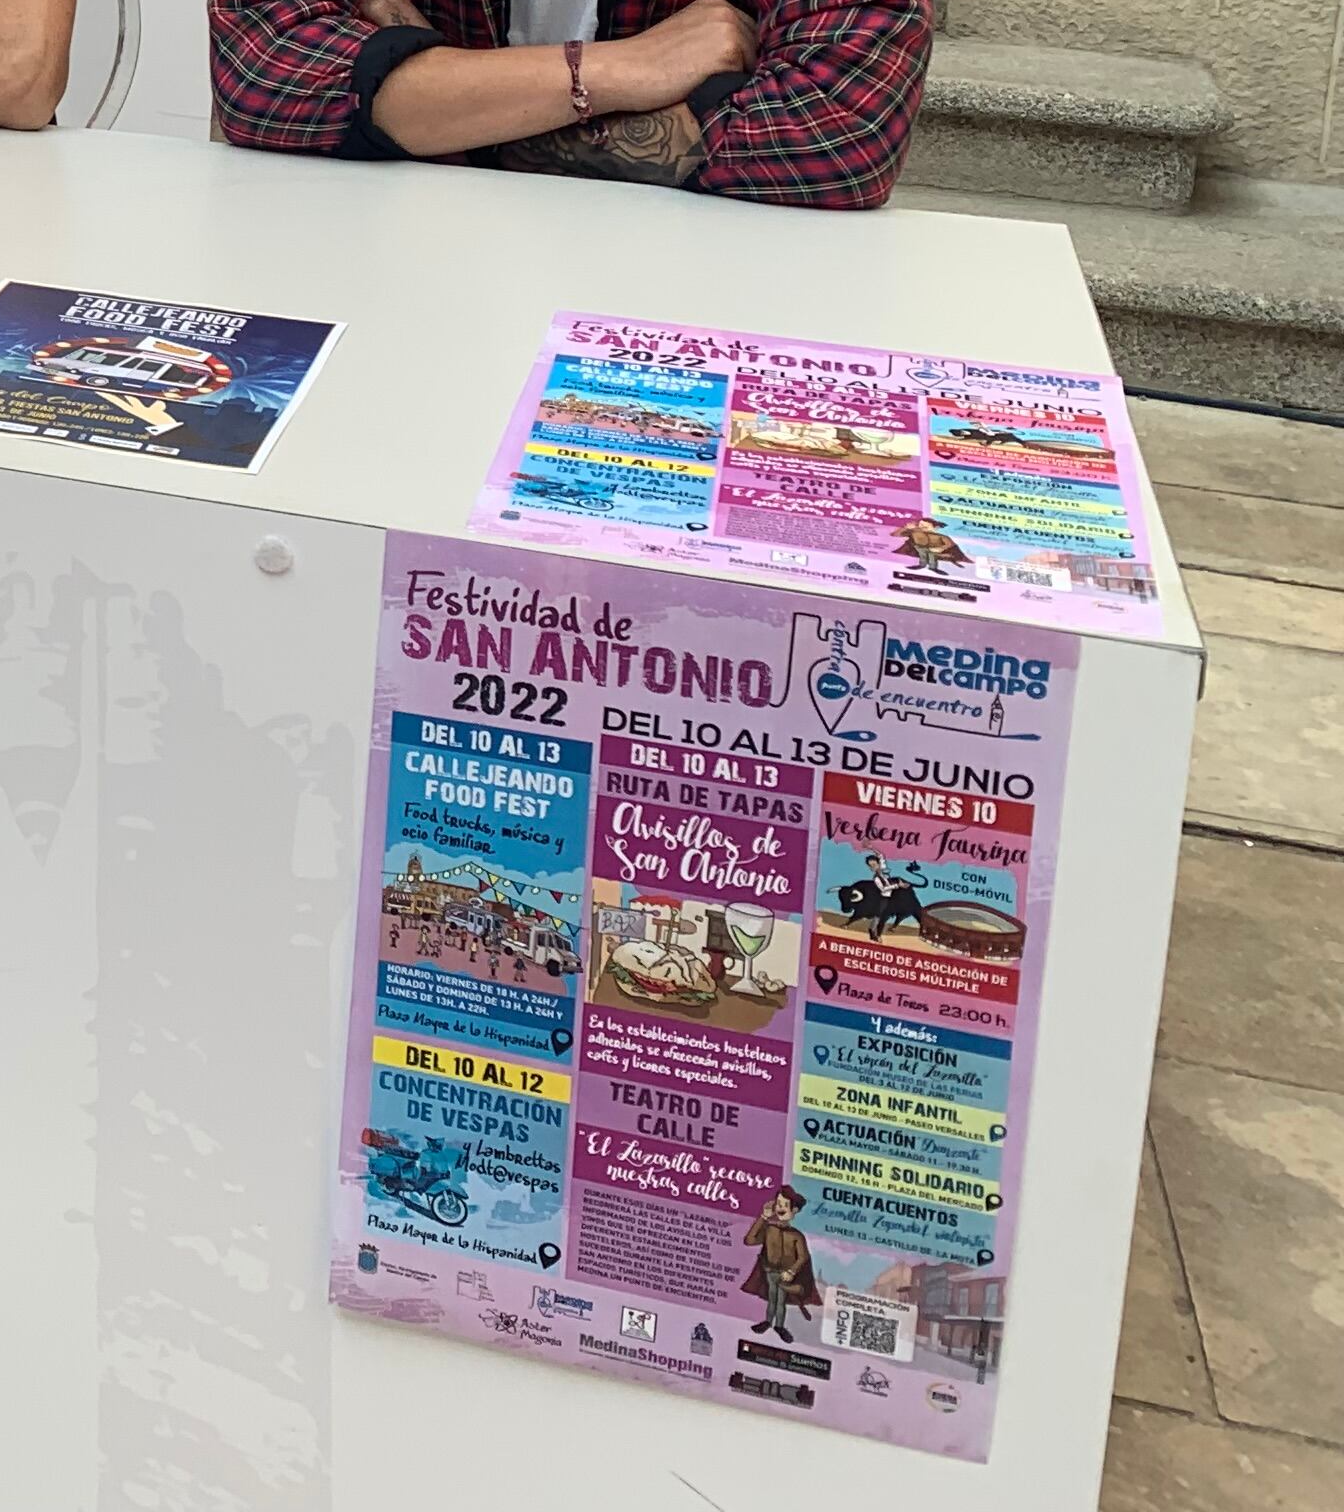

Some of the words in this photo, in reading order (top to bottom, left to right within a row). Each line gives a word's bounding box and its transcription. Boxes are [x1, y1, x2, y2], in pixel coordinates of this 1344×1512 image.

[65, 306, 144, 325] FOOD
[162, 319, 240, 337] FEST
[75, 297, 247, 328] CALLEJEANDO
[407, 570, 581, 633] Festividad
[593, 602, 633, 641] de
[401, 614, 513, 673] SAN
[530, 632, 772, 708] ANTONIO
[452, 672, 568, 727] 2022
[405, 751, 574, 799] CALLEJEANDO
[602, 706, 672, 741] DEL
[681, 720, 722, 747] 10
[729, 729, 782, 759] AL
[791, 738, 832, 766] 13
[842, 747, 894, 777] DE
[904, 758, 1035, 799] JUNIO
[425, 779, 486, 809] FOOD
[494, 790, 551, 820] FEST
[607, 772, 670, 802] RUTA
[680, 784, 708, 808] DE
[719, 791, 804, 824] TAPAS
[856, 781, 963, 819] VIERNES
[972, 801, 997, 824] 10
[402, 825, 428, 840] ocio
[404, 802, 438, 823] Food
[443, 808, 496, 837] trucks,
[502, 823, 550, 845] música
[555, 837, 564, 855] y
[613, 802, 741, 860] Avisillos
[752, 826, 786, 857] de
[605, 834, 670, 881] San
[680, 849, 791, 896] Antonio
[818, 940, 827, 950] A
[830, 941, 893, 963] BENEFICIO
[896, 954, 911, 966] DE
[915, 958, 988, 982] ASOCIACIÓN
[991, 972, 1008, 986] DE
[844, 957, 917, 981] ESCLEROSIS
[920, 972, 980, 994] MÚLTIPLE
[857, 1035, 958, 1068] EXPOSICIÓN
[379, 1071, 562, 1128] CONCENTRACIÓN
[407, 1099, 432, 1122] DE
[442, 1108, 530, 1143] VESPAS
[610, 1082, 702, 1119] TEATRO
[711, 1102, 740, 1127] DE
[836, 1086, 881, 1108] ZONA
[888, 1096, 962, 1125] INFANTIL
[637, 1113, 715, 1148] CALLE
[823, 1119, 916, 1149] ACTUACIÓN
[800, 1148, 883, 1178] SPINNING
[890, 1167, 985, 1199] SOLIDARIO
[822, 1187, 958, 1227] CUENTACUENTOS
[580, 1333, 713, 1379] MedinaShopping
